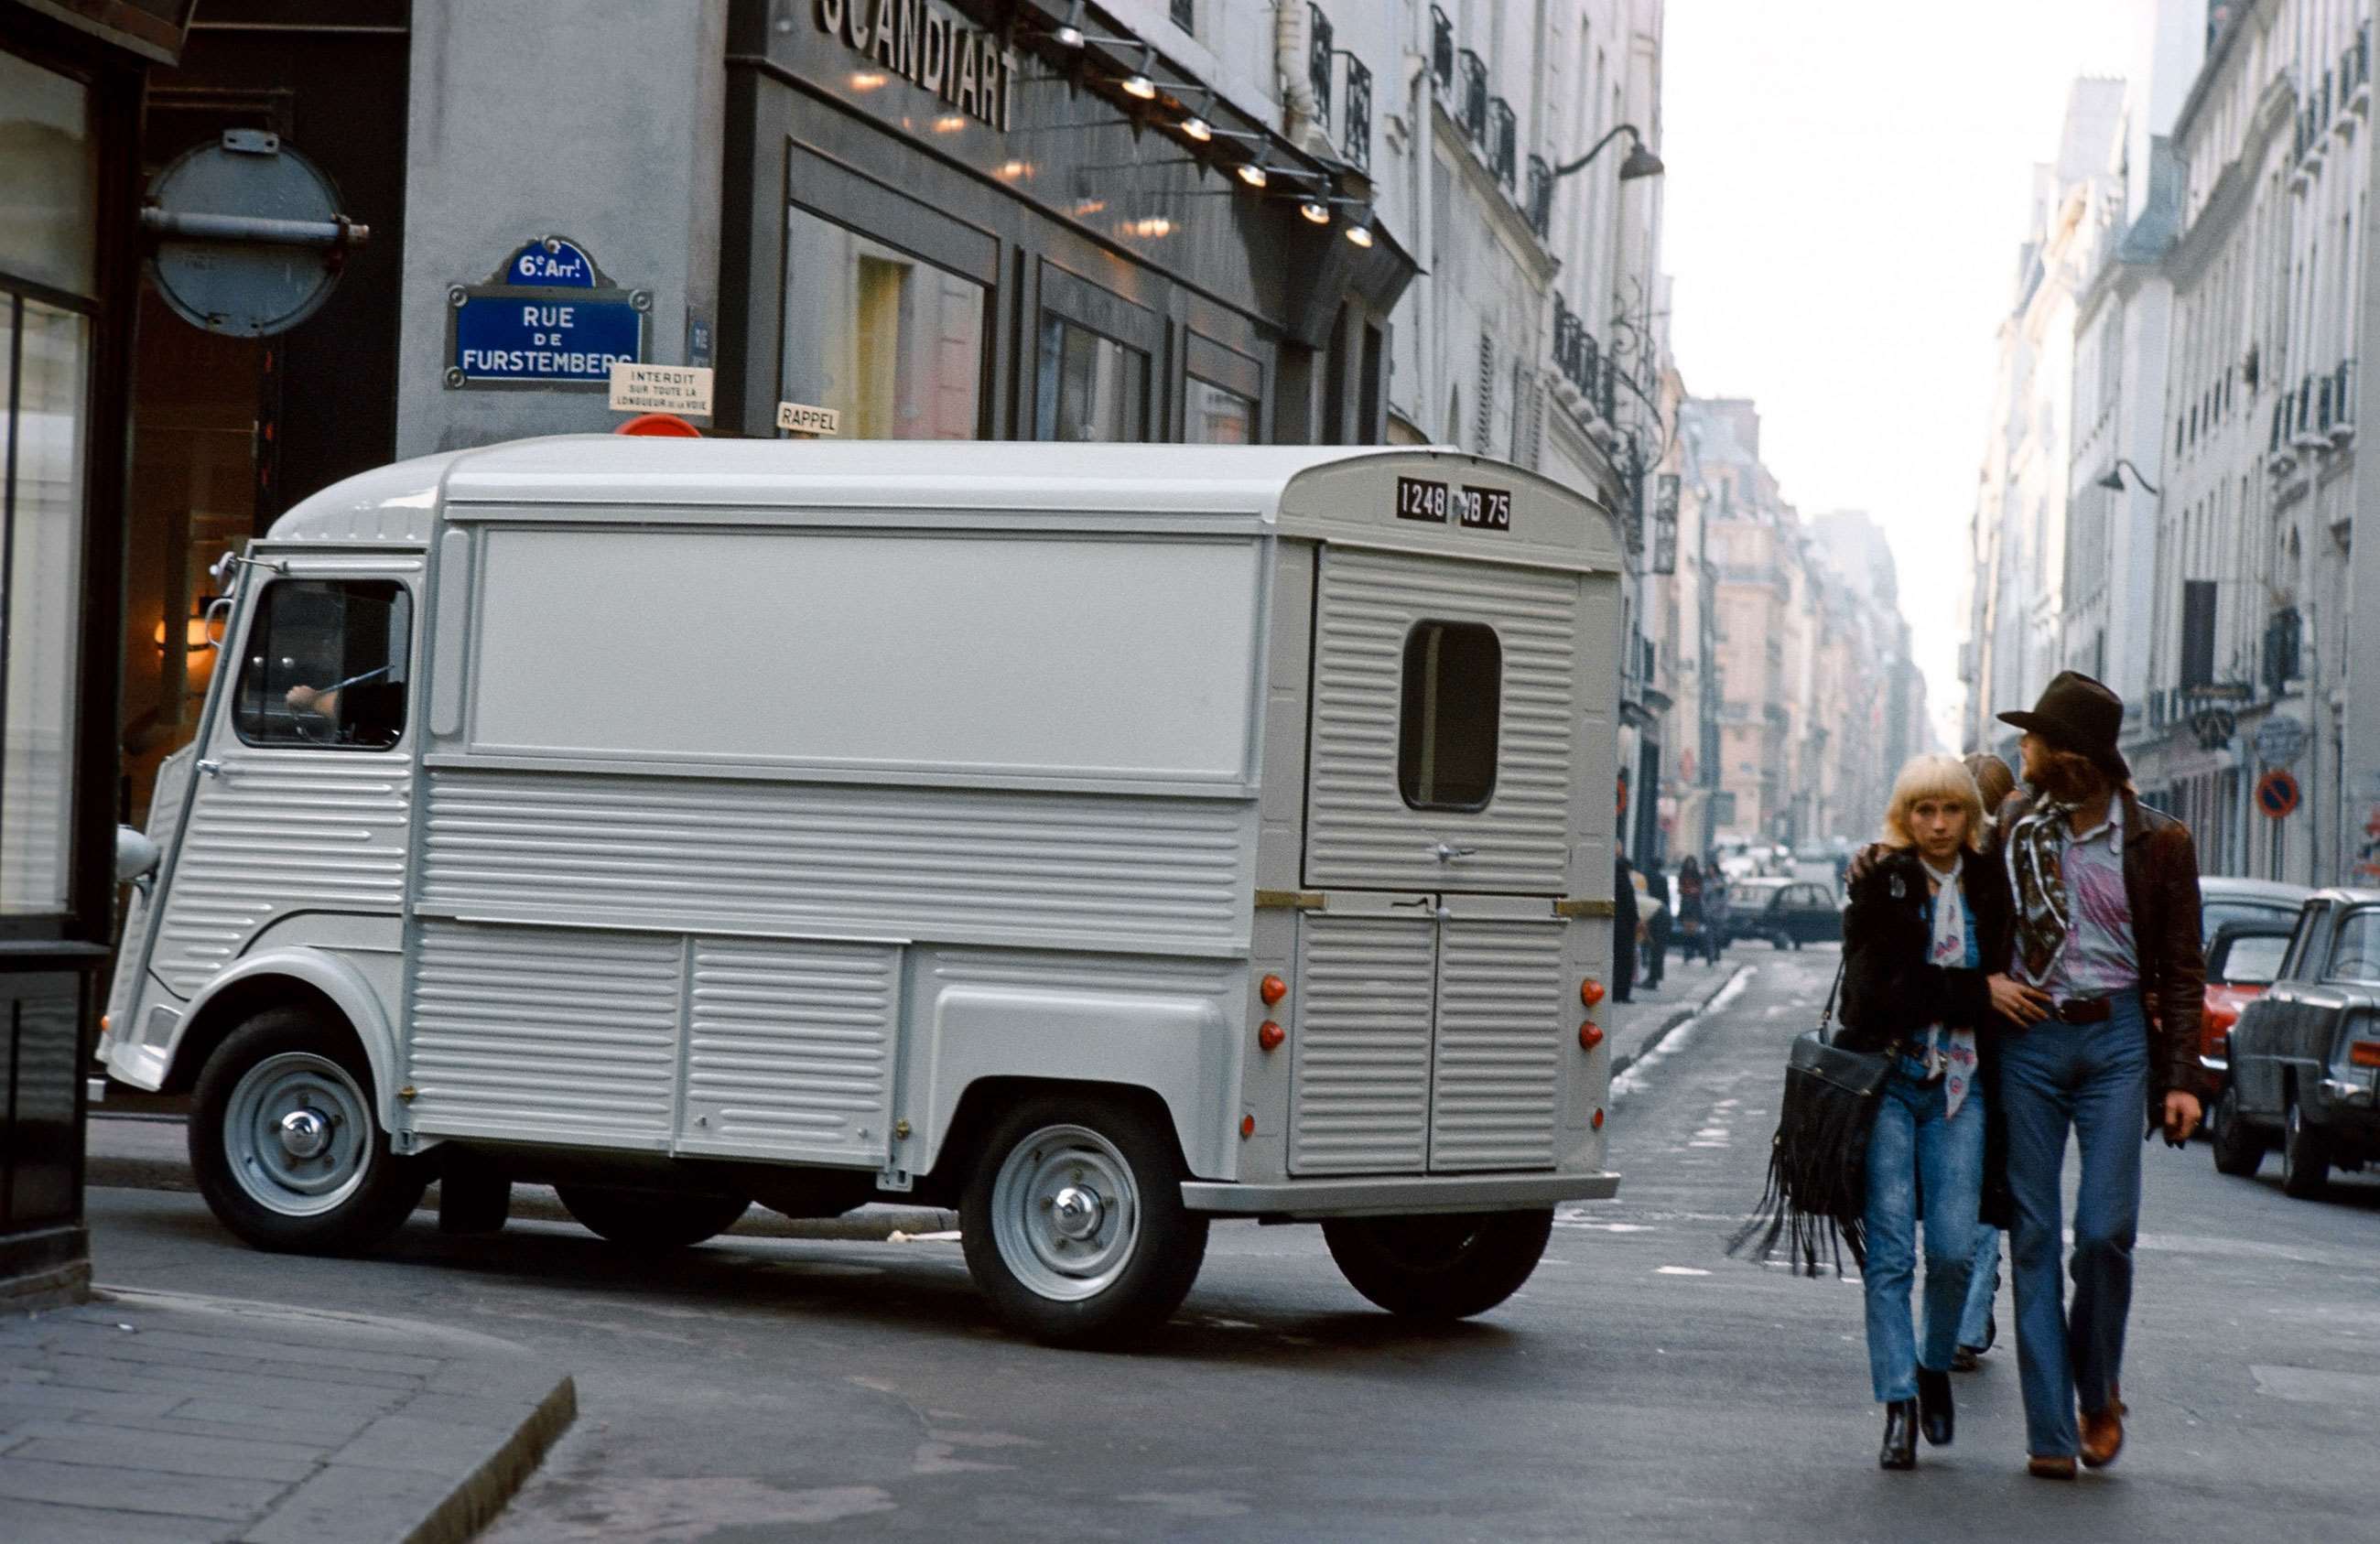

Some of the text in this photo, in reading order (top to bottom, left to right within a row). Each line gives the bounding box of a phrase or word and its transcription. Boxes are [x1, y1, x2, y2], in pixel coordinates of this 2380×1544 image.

[524, 307, 575, 328] RUE
[534, 333, 562, 346] DE
[631, 371, 695, 383] INTERDIT
[629, 384, 697, 396] SUR TOUTE LA
[616, 396, 666, 407] LONGUEUR
[783, 408, 836, 430] RAPPEL
[1402, 482, 1445, 517] 1248
[1488, 494, 1509, 524] 75
